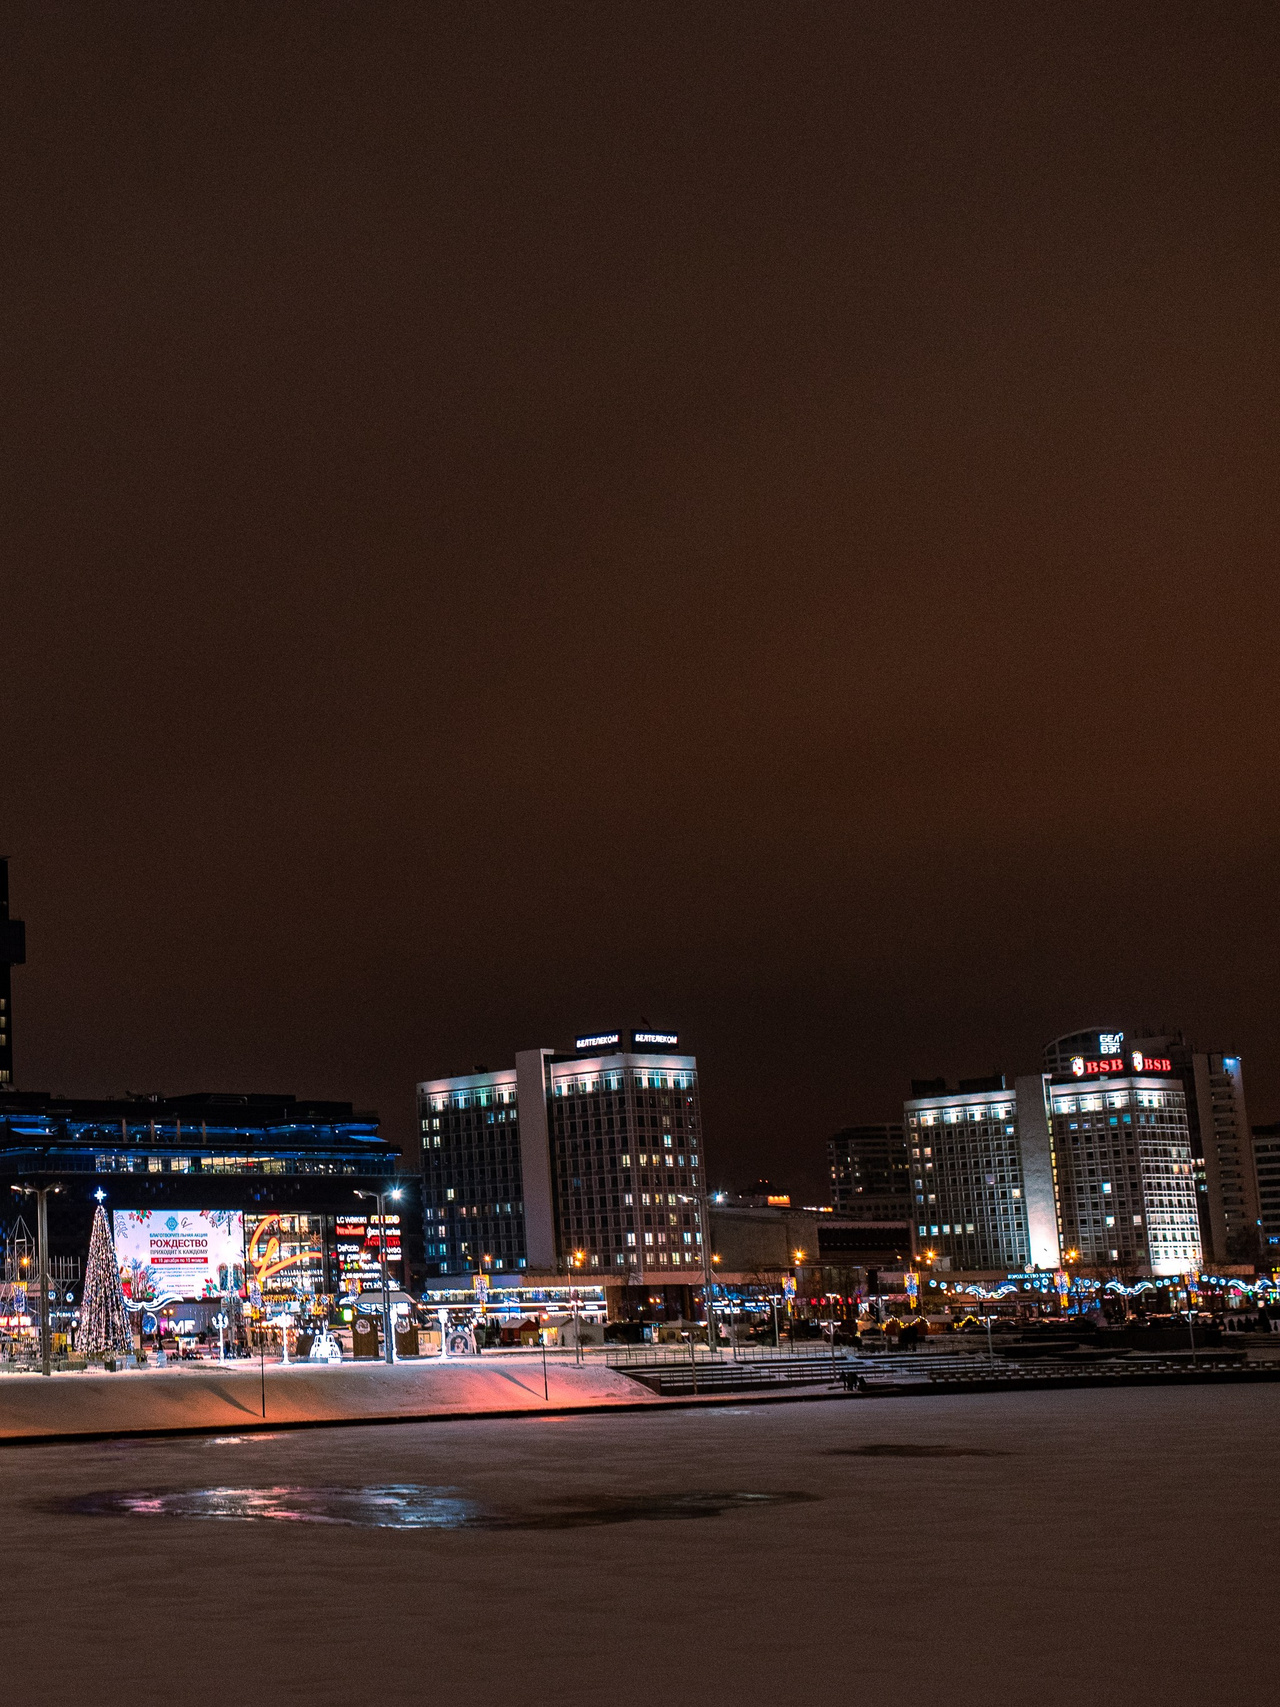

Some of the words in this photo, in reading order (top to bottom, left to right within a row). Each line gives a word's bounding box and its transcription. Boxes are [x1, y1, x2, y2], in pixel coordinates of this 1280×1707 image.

[576, 1034, 619, 1048] БЕЛТЕЛЕКОМ
[635, 1034, 678, 1044] БЕЛТЕЛЕКОМ
[1085, 1059, 1124, 1074] BSB
[1143, 1058, 1172, 1071] BSB
[150, 1239, 208, 1249] РОЖДЕСТВО
